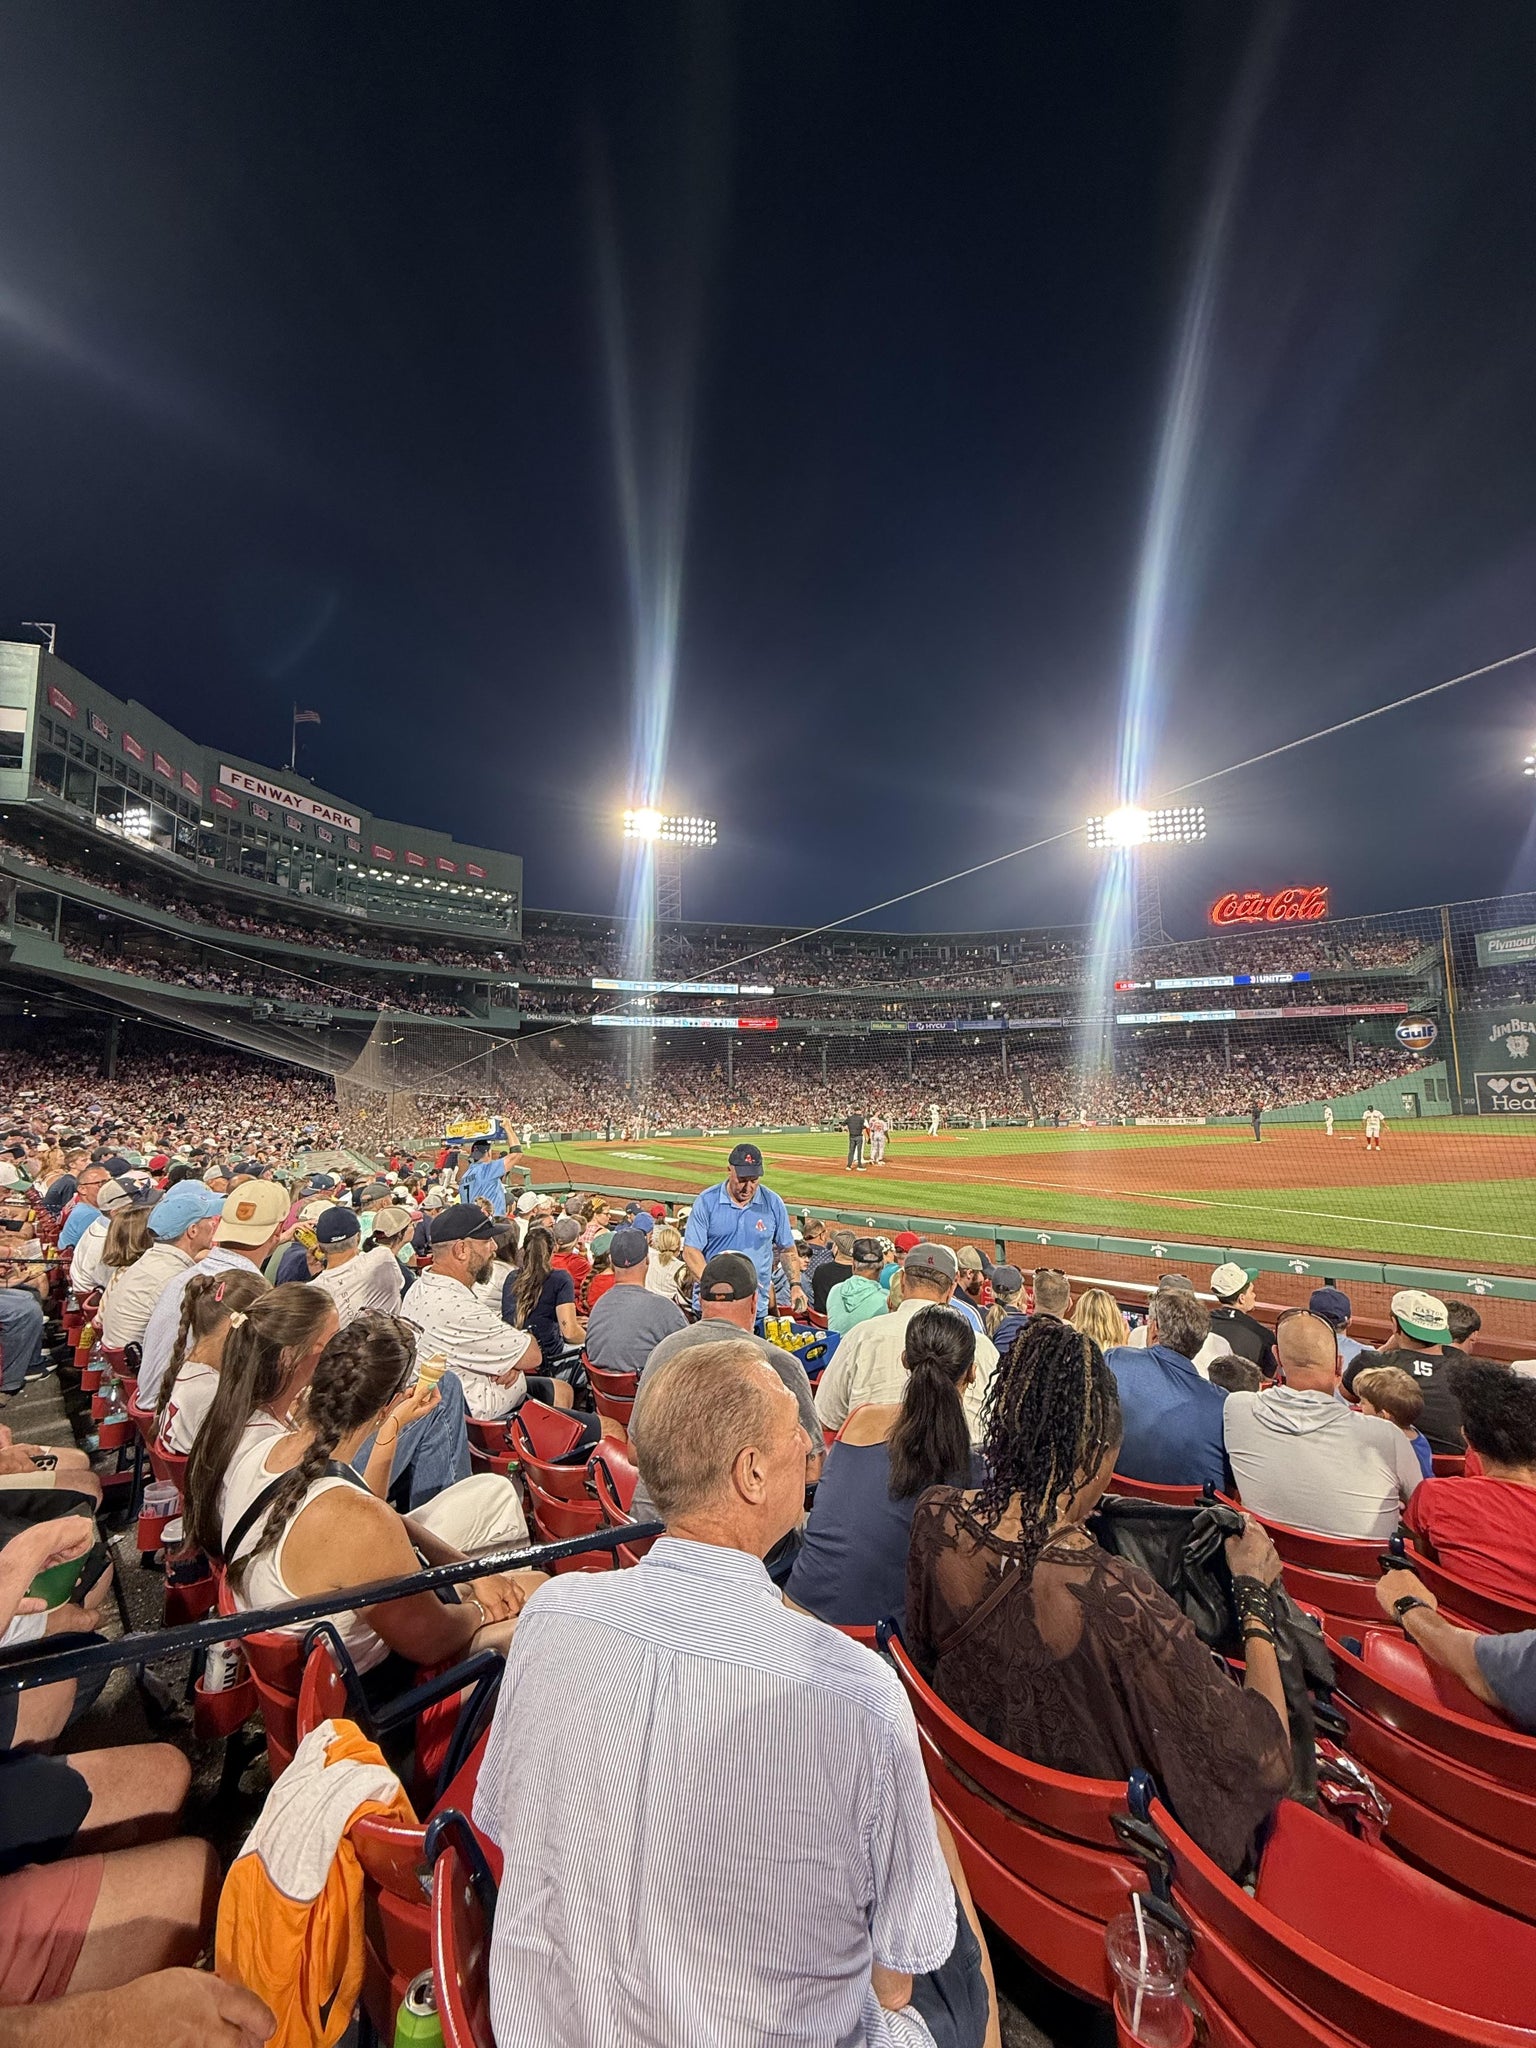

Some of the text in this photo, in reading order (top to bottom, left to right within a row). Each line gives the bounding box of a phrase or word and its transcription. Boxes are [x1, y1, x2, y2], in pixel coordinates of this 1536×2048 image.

[231, 773, 302, 808] FENWAY
[312, 804, 352, 828] PARK
[1212, 886, 1328, 925] Coca-Cola
[1260, 974, 1293, 984] UNITED
[1397, 1025, 1434, 1039] Gulf
[1511, 1018, 1536, 1033] BEA
[1510, 1077, 1536, 1094] CV
[1491, 1095, 1536, 1111] Hea
[1413, 1360, 1433, 1377] 15
[222, 1662, 238, 1690] ULY
